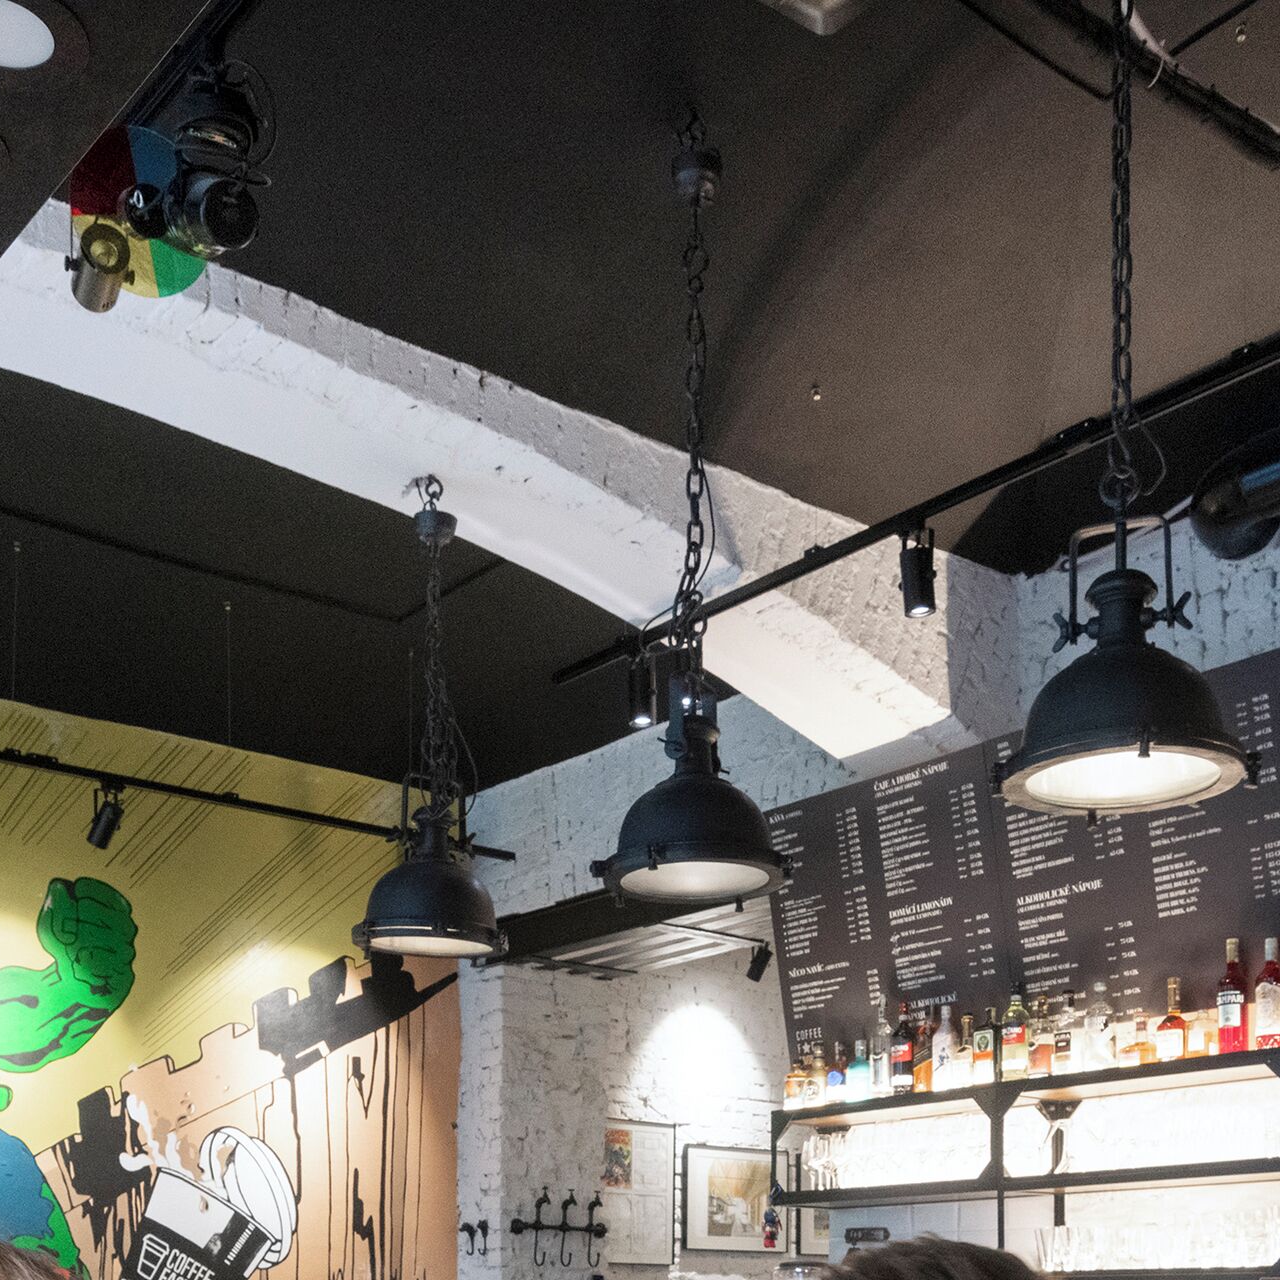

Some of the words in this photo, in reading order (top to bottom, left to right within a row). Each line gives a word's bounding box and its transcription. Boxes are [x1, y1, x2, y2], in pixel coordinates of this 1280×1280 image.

[1016, 882, 1071, 906] ALKOHOLICKÉ
[1071, 879, 1104, 895] NÁPOJE
[888, 901, 917, 920] DOMÁCÍ
[917, 896, 954, 913] LIMONÁDY
[795, 1027, 822, 1041] COFFEE
